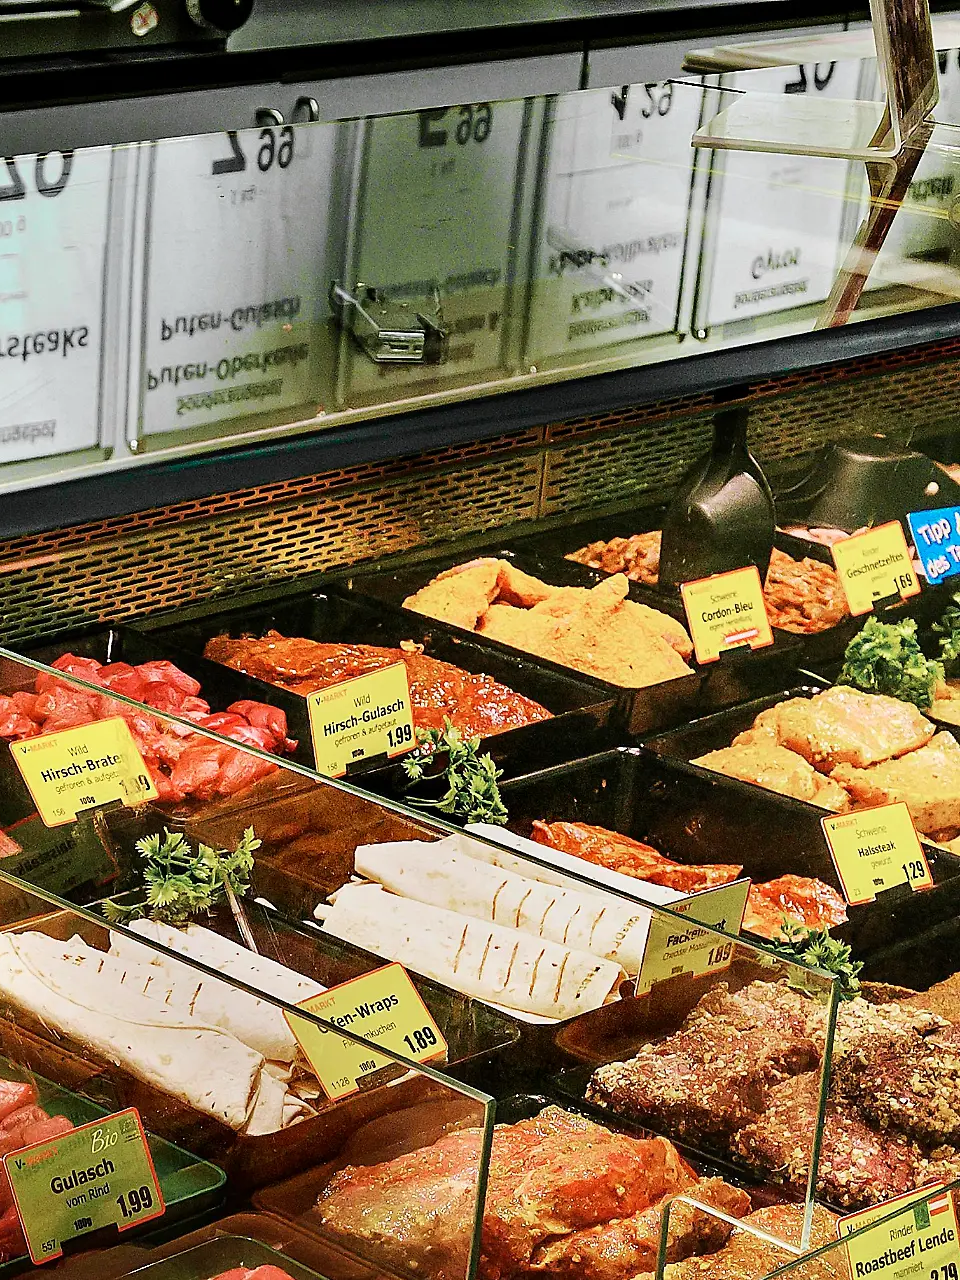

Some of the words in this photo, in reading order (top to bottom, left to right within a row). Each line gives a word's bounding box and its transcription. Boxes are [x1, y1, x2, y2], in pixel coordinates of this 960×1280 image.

[917, 519, 951, 545] Tipp
[847, 553, 904, 578] Geschnetzeltes
[927, 555, 950, 578] des
[702, 602, 753, 622] Cordon-Bleu
[354, 694, 371, 707] Wild
[324, 699, 405, 736] Hirsch-Gulasch
[387, 724, 412, 748] 1,99
[68, 744, 88, 757] Wild
[55, 780, 85, 795] gefroren
[80, 796, 96, 805] 100g
[858, 841, 896, 858] Halssteak
[902, 860, 925, 881] 1,29
[403, 1026, 437, 1054] 1,89
[331, 1077, 350, 1090] 1128
[91, 1128, 118, 1154] Bio
[50, 1158, 115, 1194] Gulasch
[66, 1194, 86, 1208] vom
[89, 1182, 110, 1200] Rind
[116, 1186, 153, 1218] 1,99
[74, 1217, 92, 1230] 100g
[890, 1224, 914, 1241] Rinder
[42, 1239, 56, 1252] 557
[855, 1240, 916, 1278] Roastbeef
[918, 1228, 955, 1253] Lende
